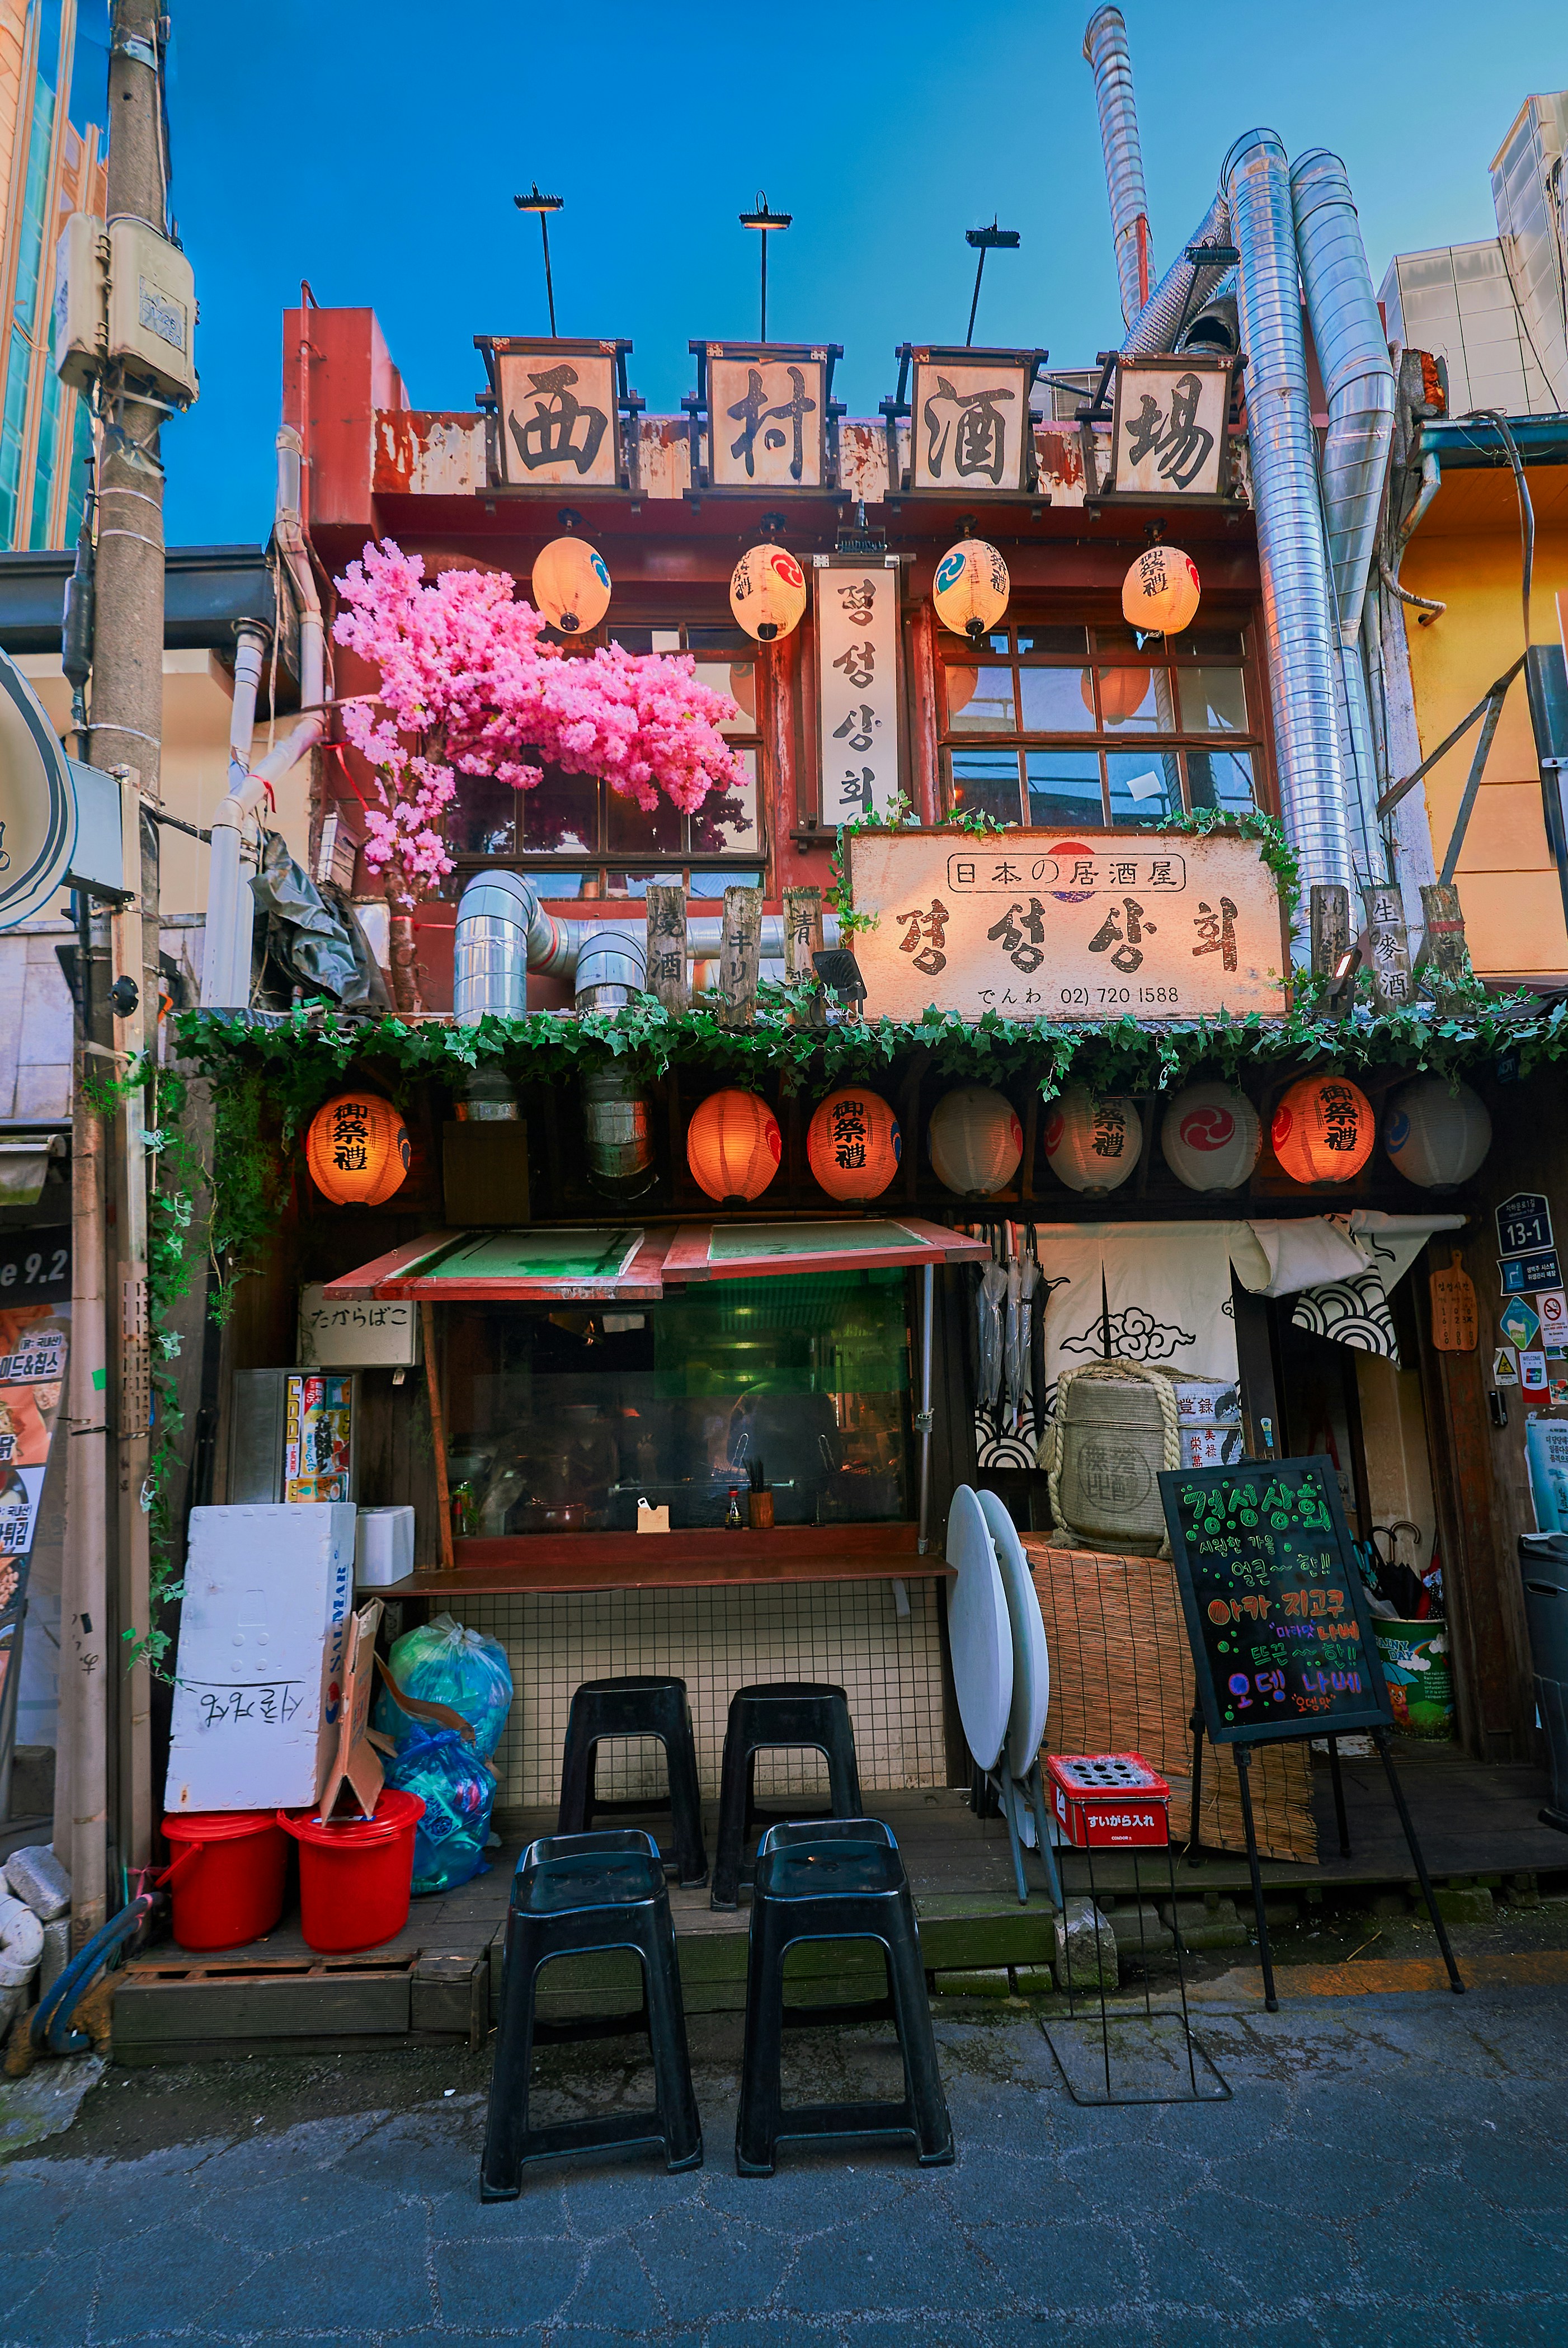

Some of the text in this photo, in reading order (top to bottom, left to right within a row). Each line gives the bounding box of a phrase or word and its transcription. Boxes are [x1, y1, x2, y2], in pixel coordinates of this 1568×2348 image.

[508, 364, 608, 475] 西
[727, 366, 816, 480] 村
[925, 375, 1015, 485] 酒
[1125, 373, 1214, 490] 場
[832, 578, 883, 814] 경성상회
[956, 859, 1178, 886] 日本の居酒屋
[896, 896, 1239, 976] 경성상회
[1373, 898, 1408, 998] 生麥酒
[727, 930, 753, 1011] キリン
[978, 987, 1179, 1006] でんわ 02) 720 1588
[1506, 1218, 1542, 1246] 13-1
[24, 1249, 68, 1284] 9.2
[1527, 1265, 1540, 1273] 생맥주
[1528, 1272, 1546, 1281] 위생관리
[1183, 1483, 1331, 1535] 경성상회
[1199, 1535, 1275, 1558] 시원한 가을
[1317, 1620, 1360, 1642] 나베
[1387, 1650, 1414, 1661] DAY
[1228, 1668, 1362, 1709] 오뎅 나베
[1087, 1815, 1155, 1828] すいがら入れ
